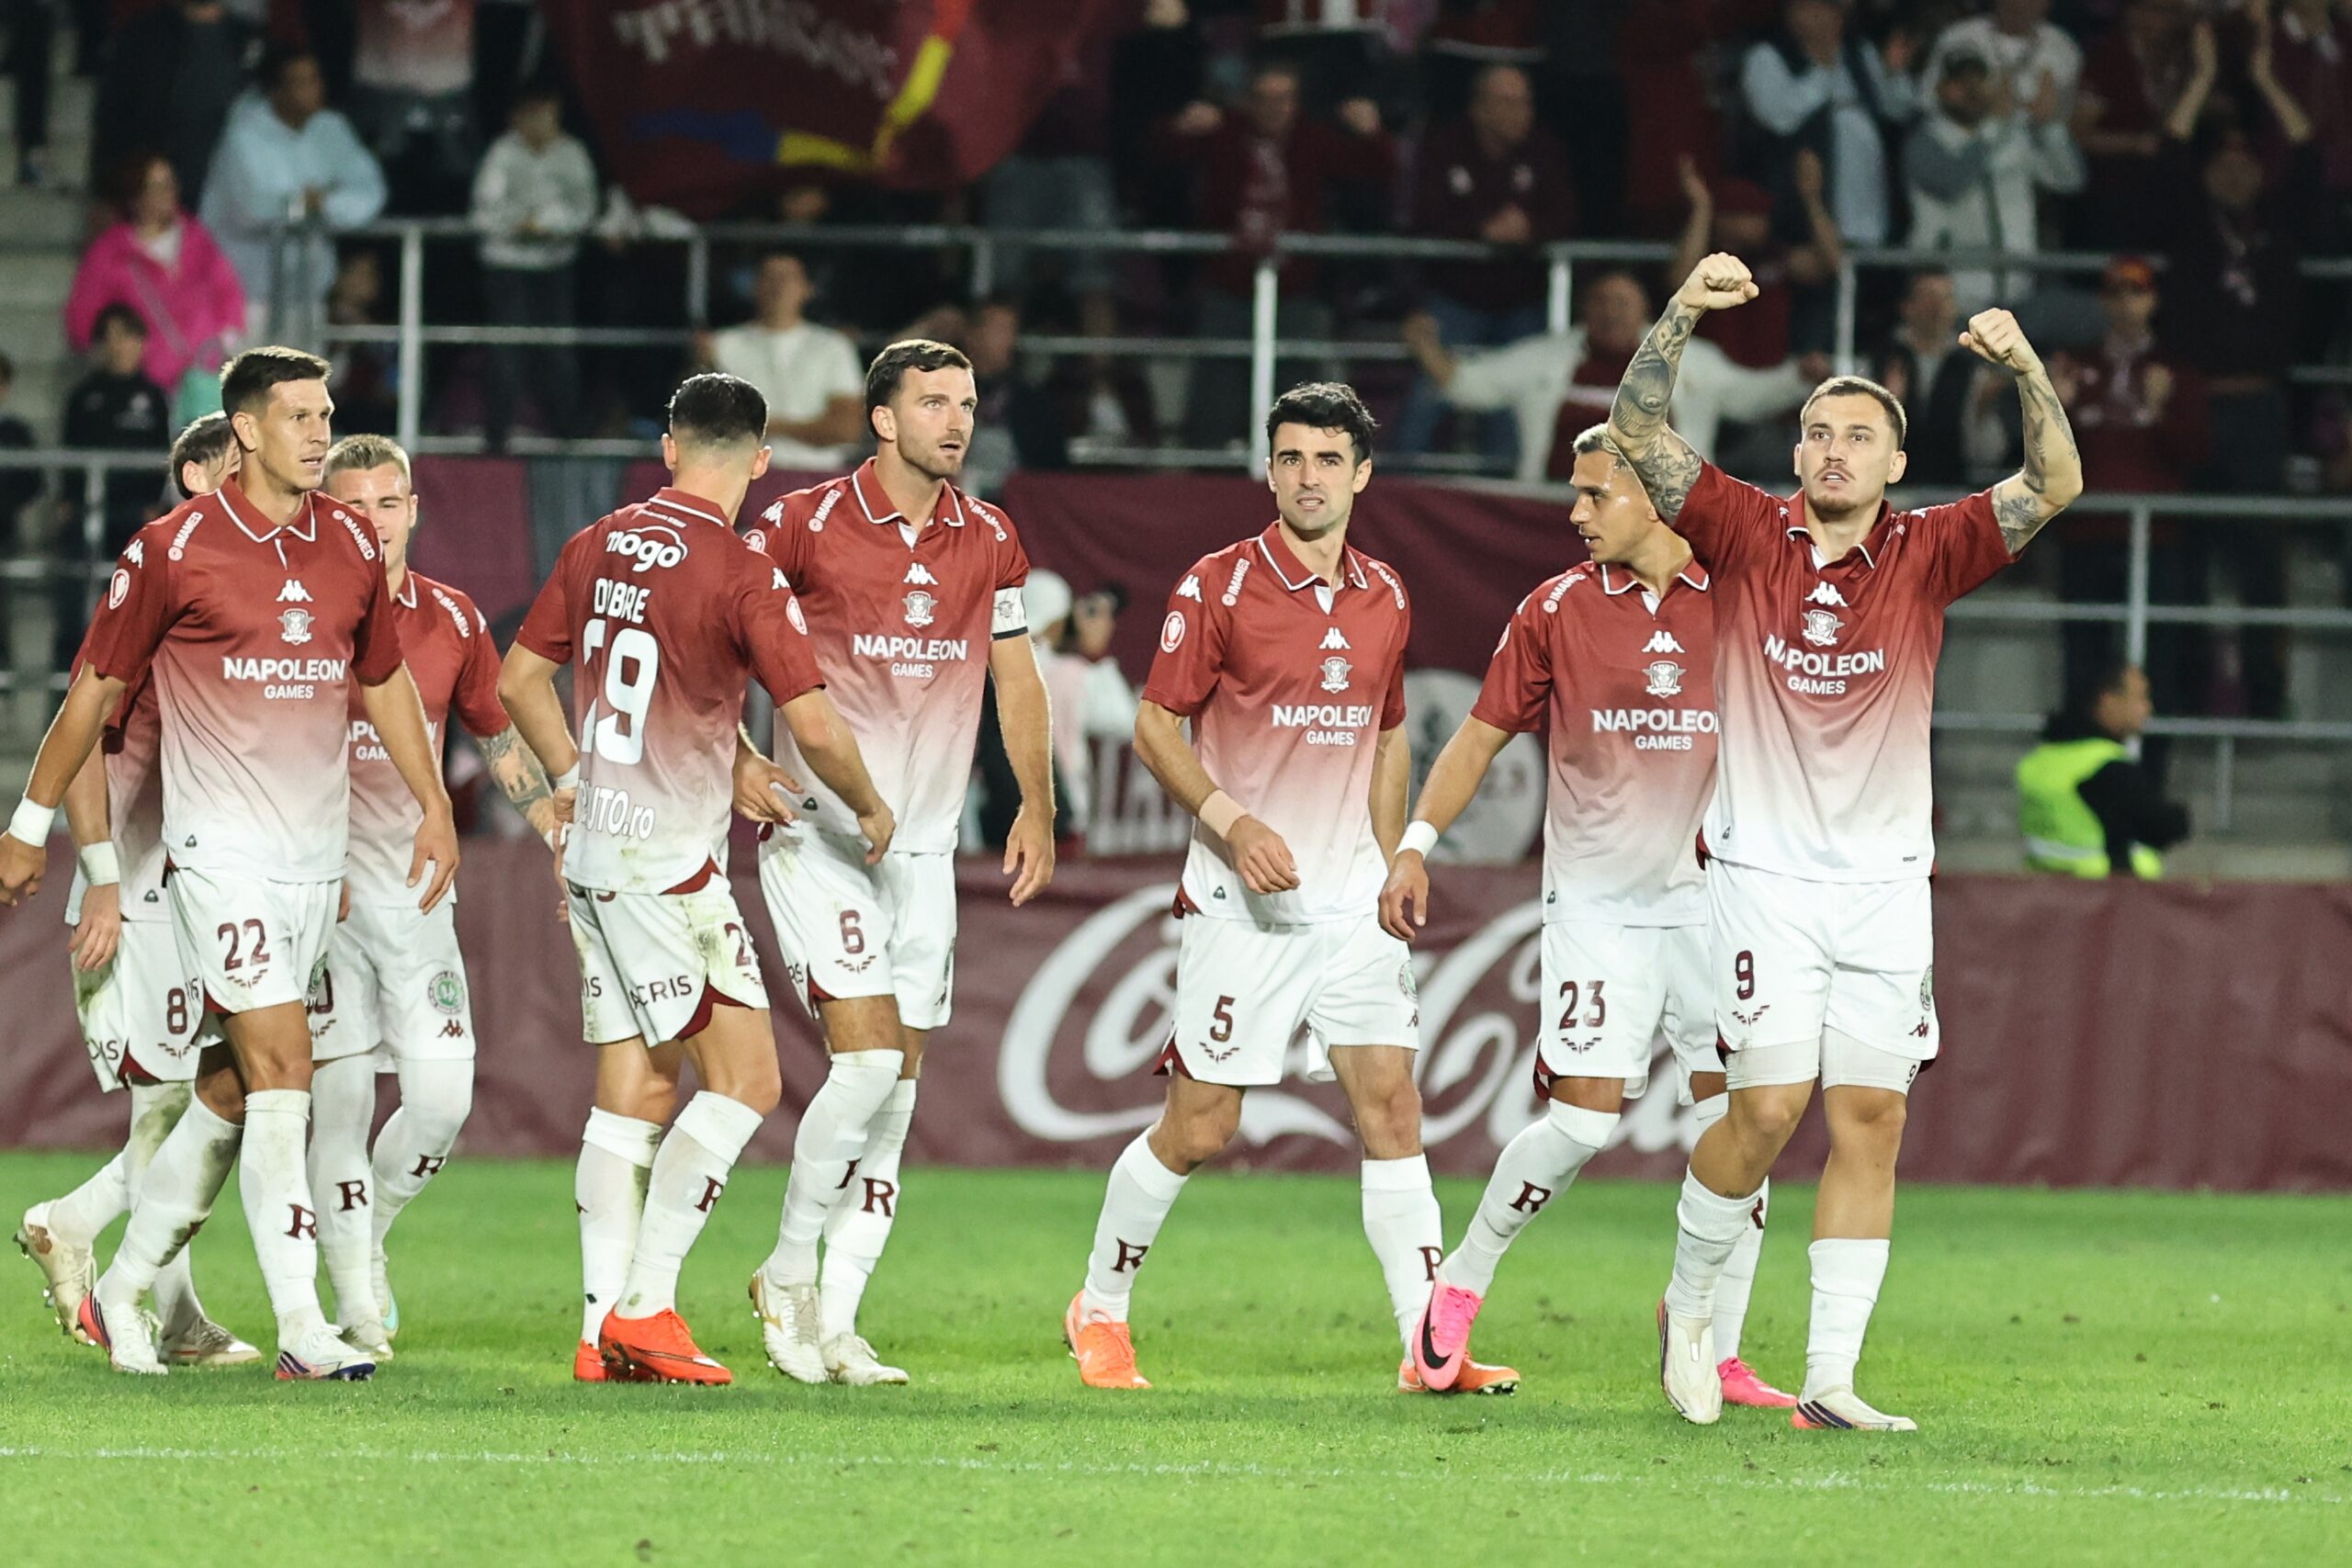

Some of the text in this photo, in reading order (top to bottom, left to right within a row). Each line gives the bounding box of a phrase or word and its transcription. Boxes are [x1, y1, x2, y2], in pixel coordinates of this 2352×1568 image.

[343, 515, 375, 560] IMAMED
[605, 530, 683, 572] mogo
[594, 577, 650, 625] DIBRE
[853, 634, 968, 661] NAPOLEON
[221, 656, 346, 681] NAPOLEON
[890, 662, 934, 678] GAMES
[1787, 675, 1847, 694] GAMES
[264, 683, 314, 699] GAMES
[1306, 729, 1355, 747] GAMES
[1590, 708, 1720, 734] NAPOLEO
[355, 745, 391, 761] GAM
[1634, 735, 1693, 750] GAMES
[217, 918, 270, 972] 22
[840, 908, 865, 955] 6
[1734, 950, 1756, 1000] 9
[166, 987, 187, 1035] 8
[1209, 996, 1236, 1043] 5
[1558, 979, 1606, 1031] 23
[335, 1179, 369, 1213] R
[860, 1177, 895, 1218] R
[1509, 1179, 1552, 1213] R
[284, 1203, 317, 1240] R
[1110, 1236, 1149, 1273] R
